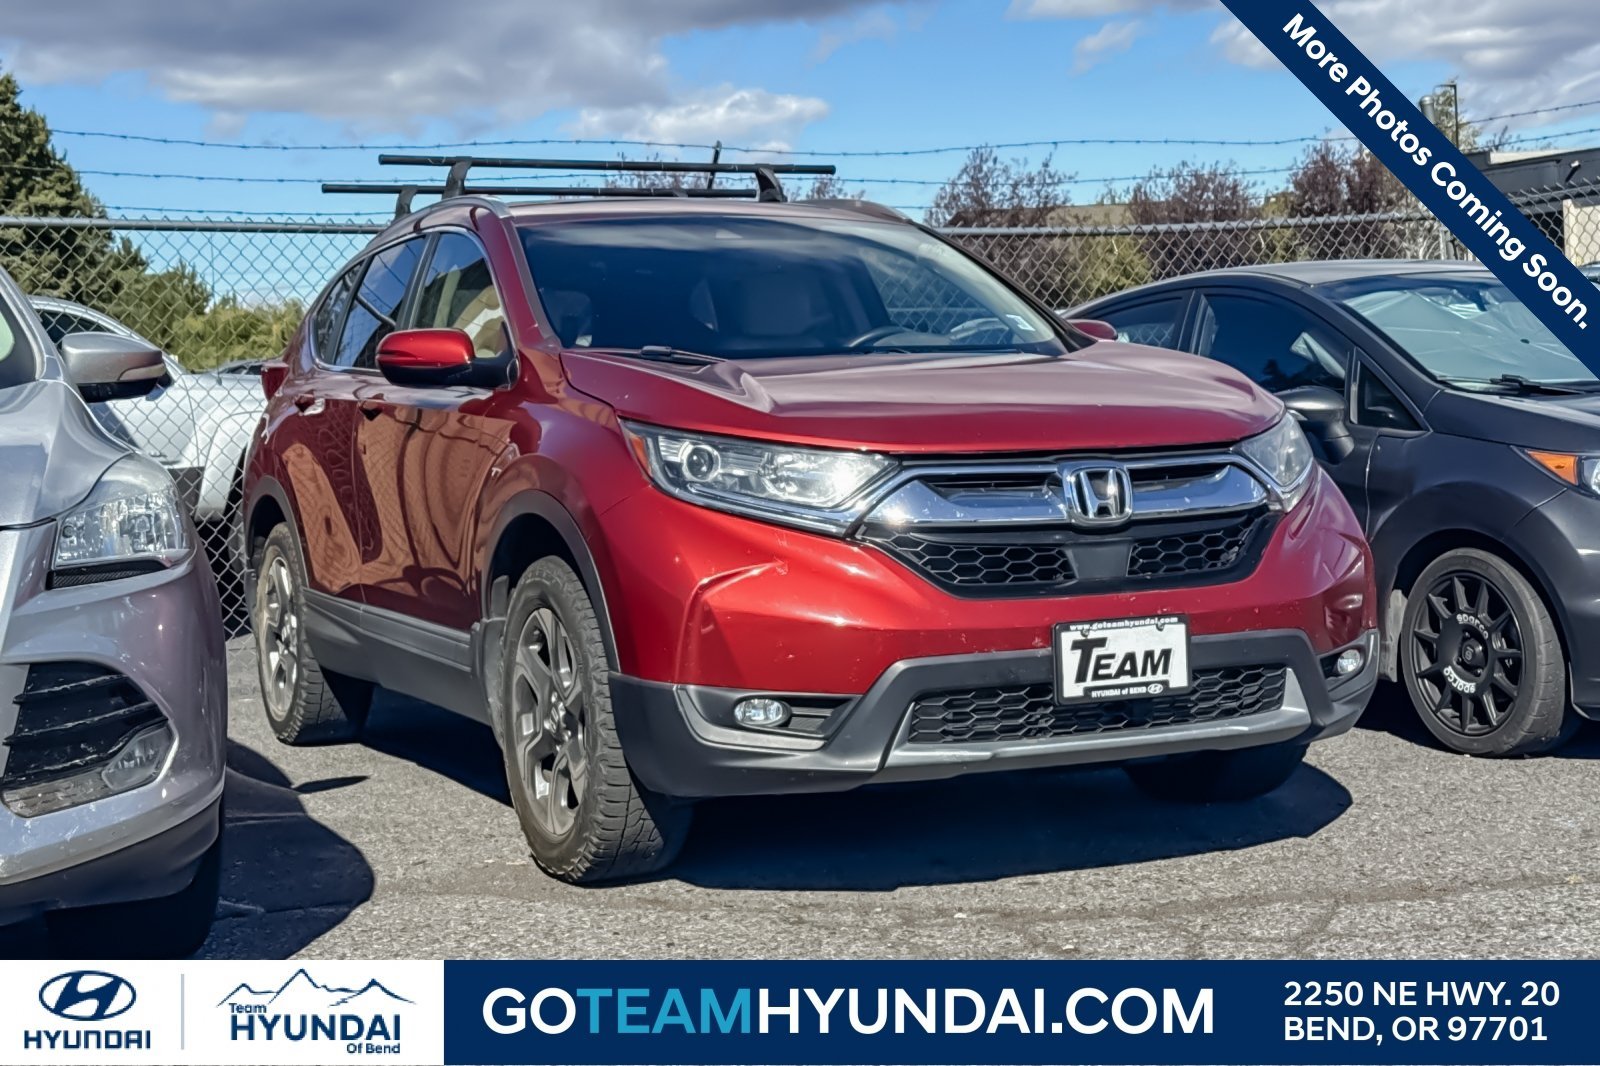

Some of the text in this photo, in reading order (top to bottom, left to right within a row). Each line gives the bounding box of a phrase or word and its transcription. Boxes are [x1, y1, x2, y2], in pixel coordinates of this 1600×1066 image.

[1069, 616, 1179, 632] www.goteamhyundai.com
[1070, 636, 1173, 684] TEAM
[1091, 688, 1121, 698] HYUNDAI
